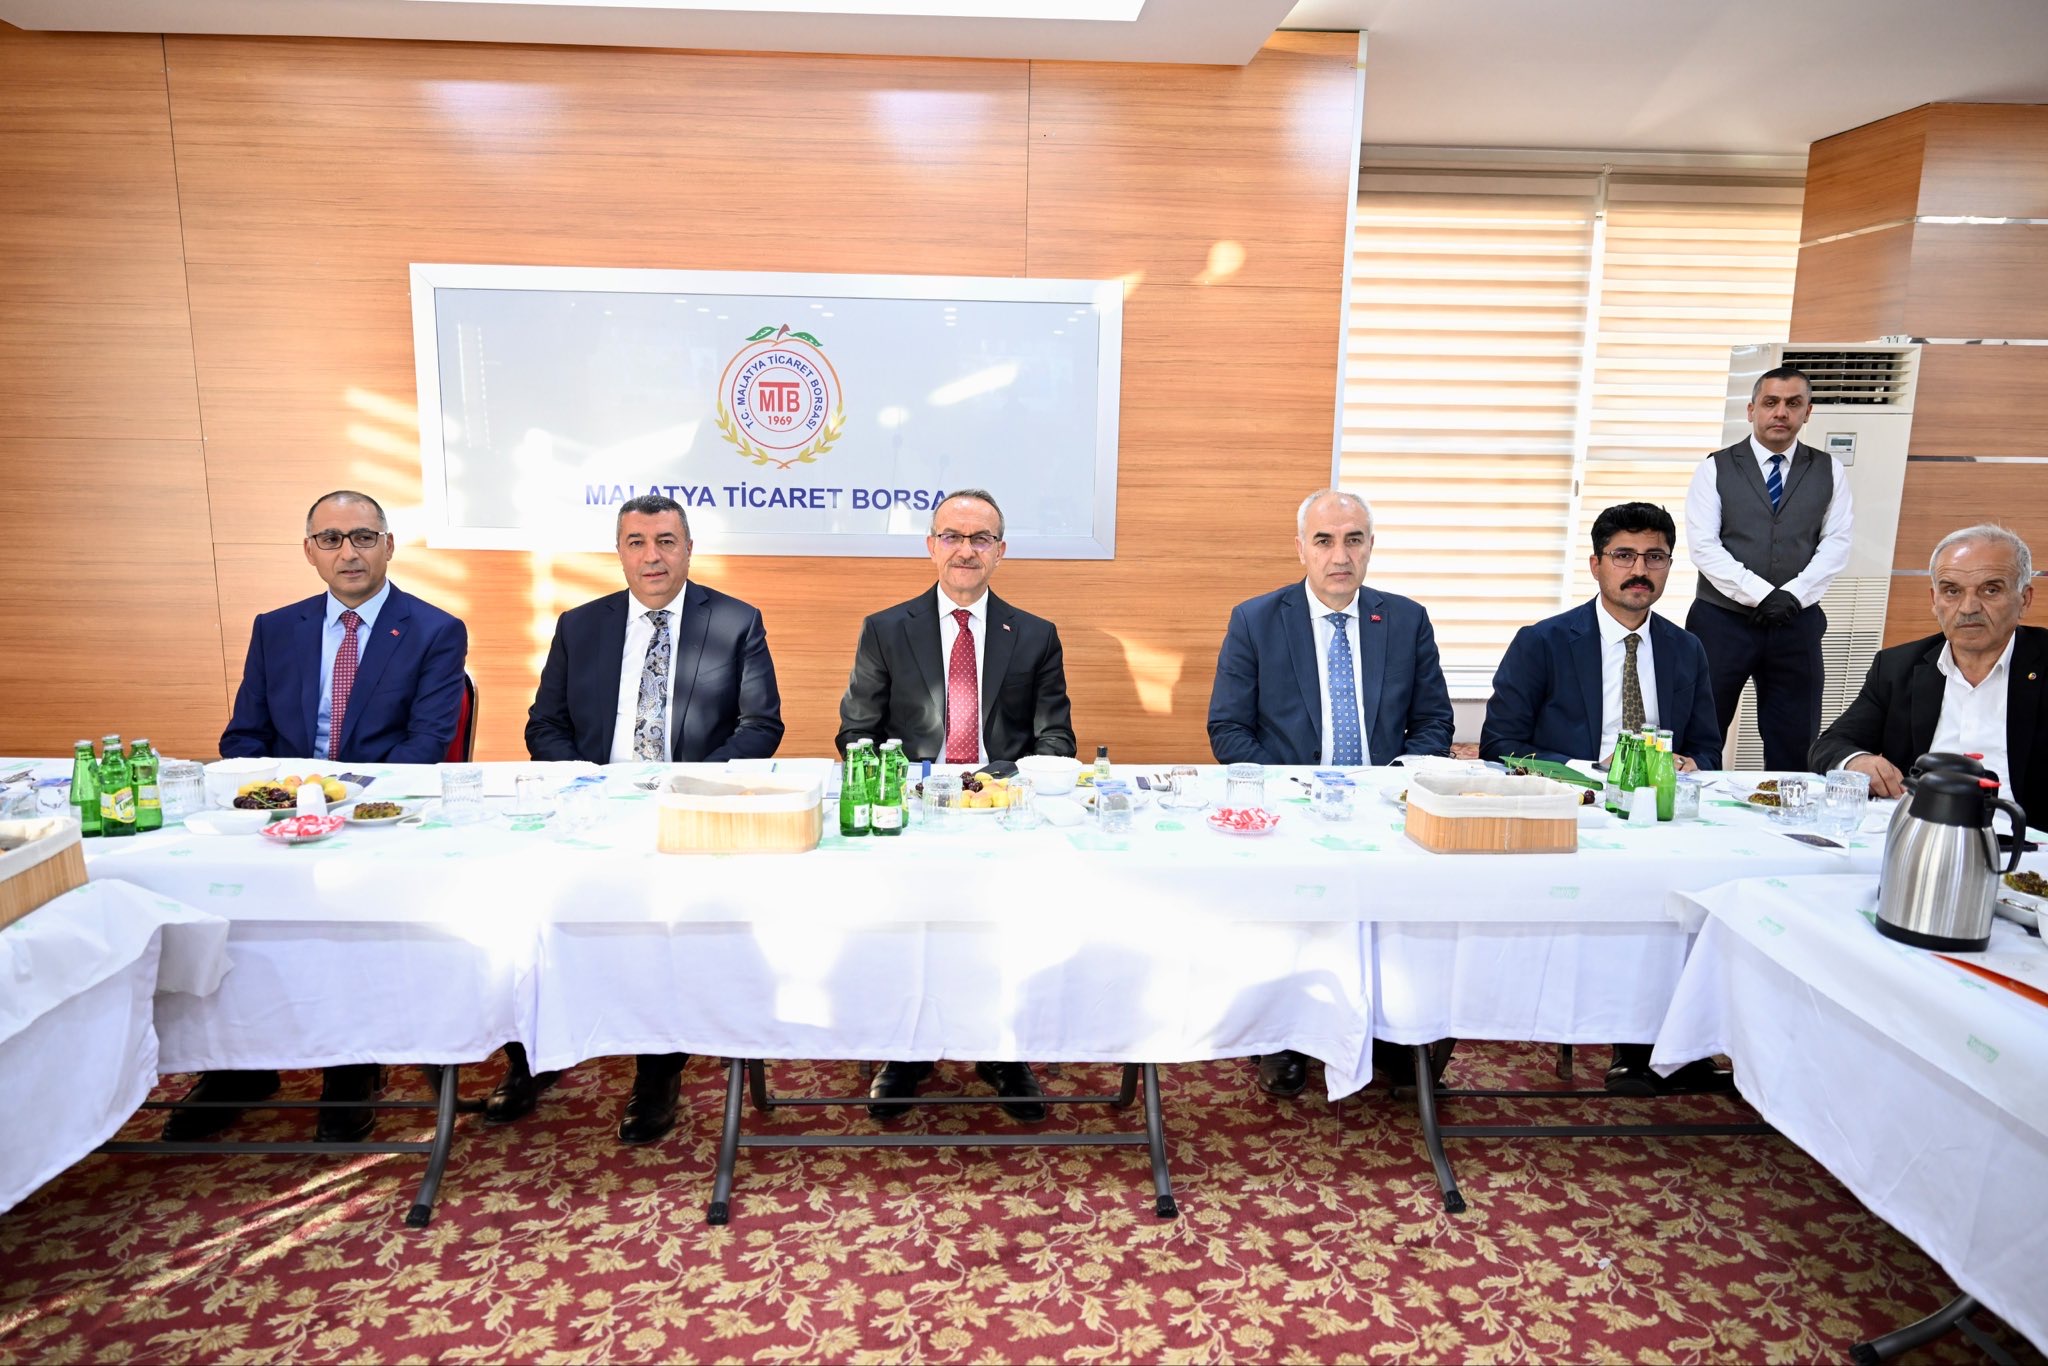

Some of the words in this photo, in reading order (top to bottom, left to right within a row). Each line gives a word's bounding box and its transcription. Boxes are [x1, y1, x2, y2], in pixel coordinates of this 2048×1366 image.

[737, 360, 766, 406] MALATYA
[767, 353, 814, 378] TİCARET
[806, 379, 823, 430] BORSASI
[758, 381, 800, 413] MTB
[768, 415, 793, 426] 1969
[723, 481, 843, 509] TİCARET
